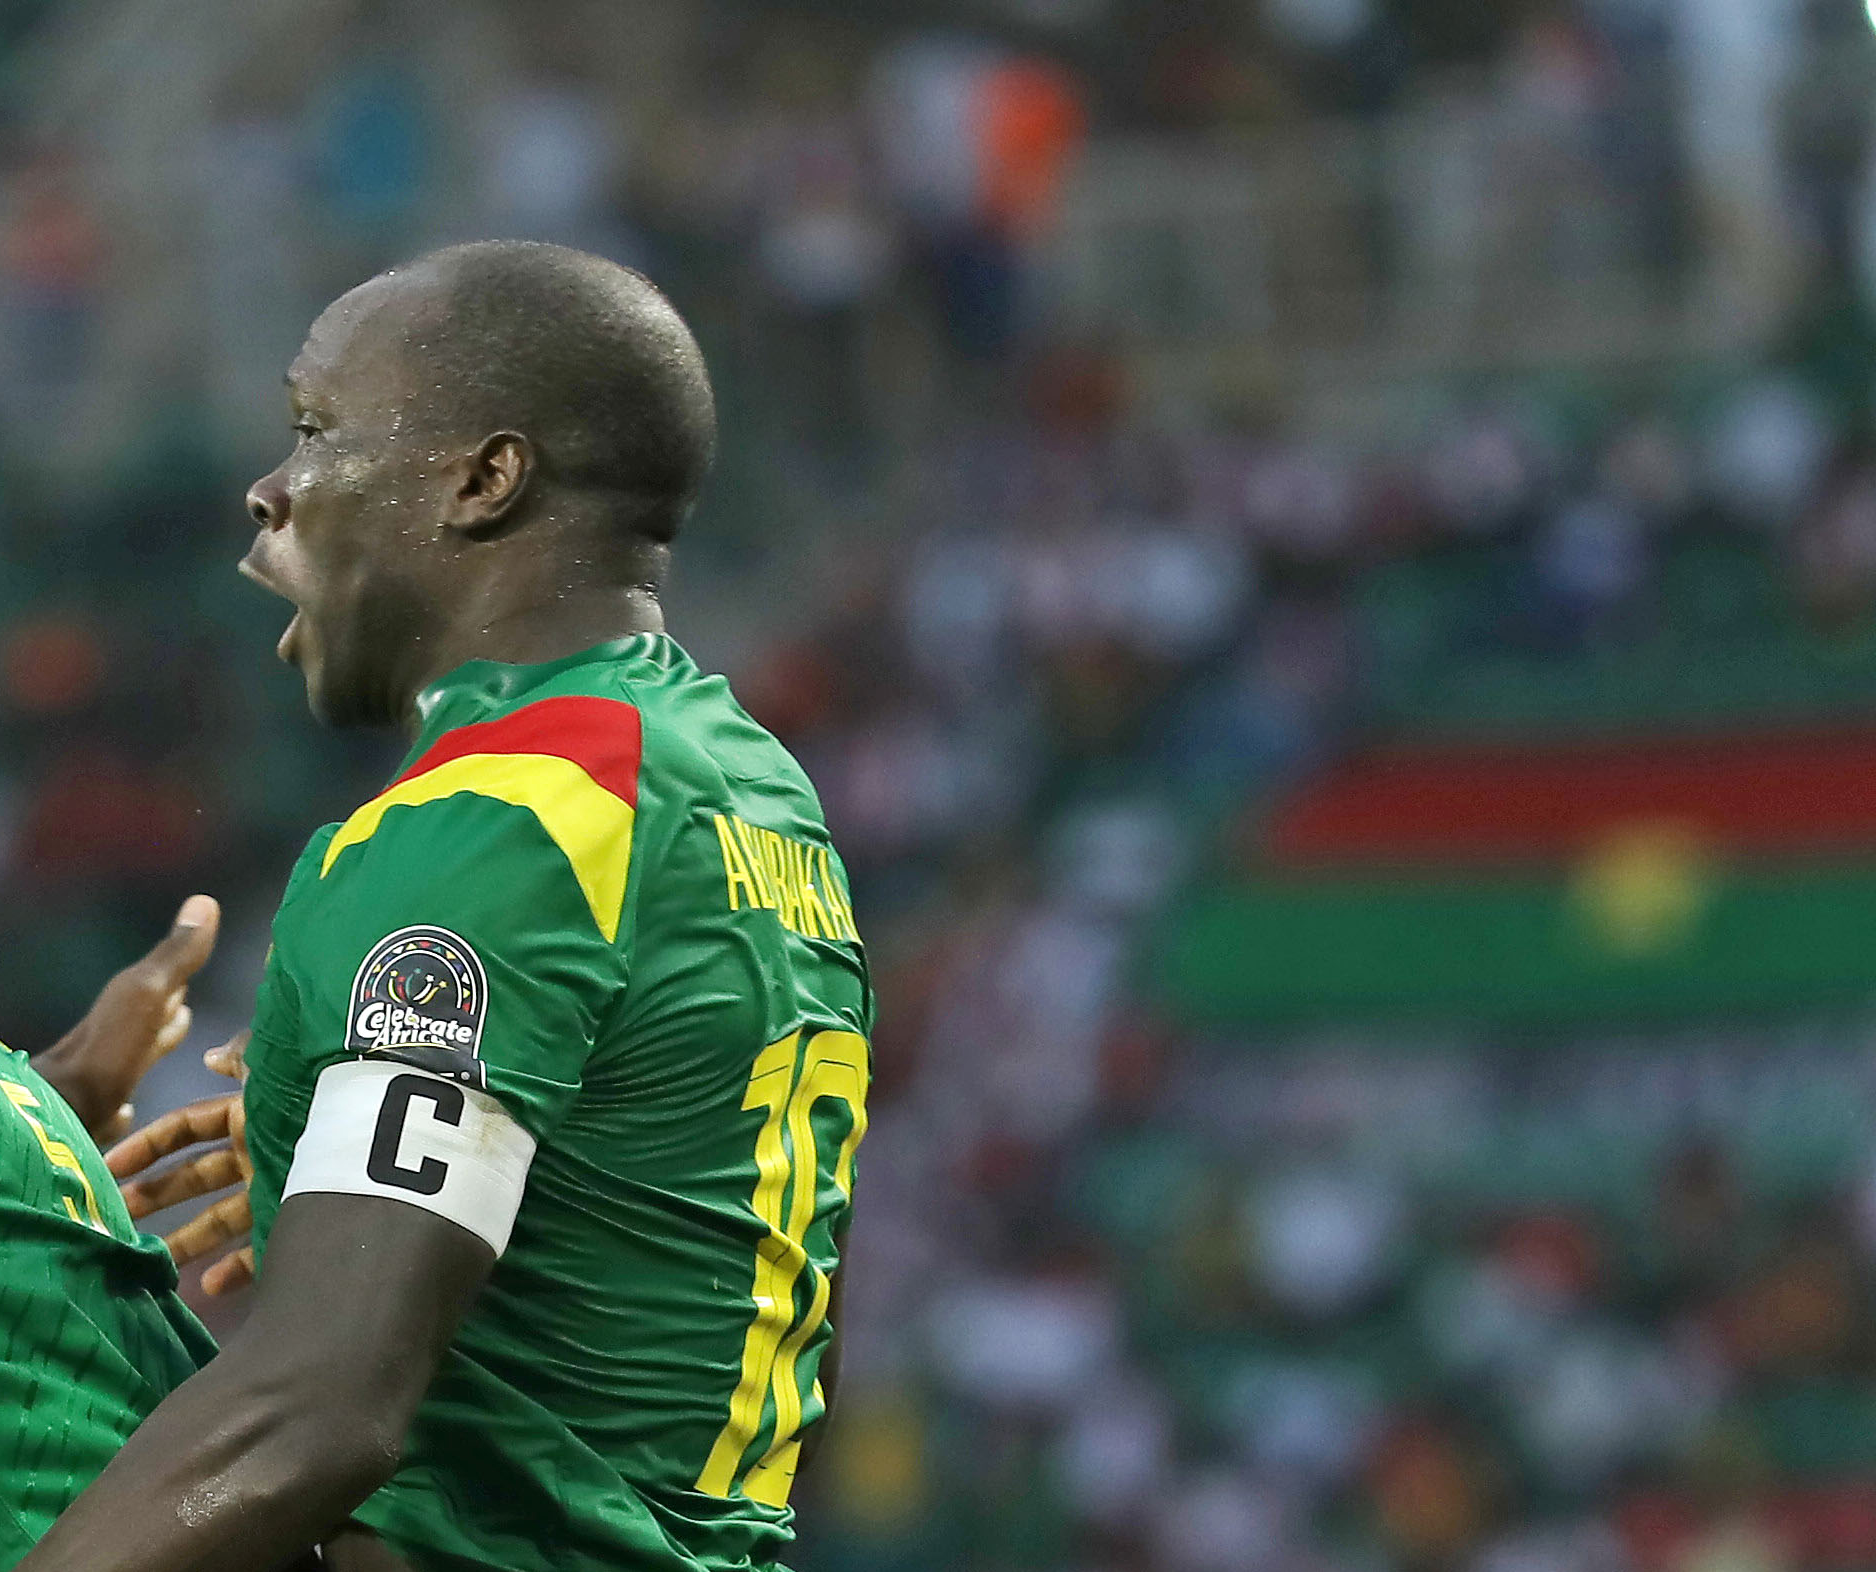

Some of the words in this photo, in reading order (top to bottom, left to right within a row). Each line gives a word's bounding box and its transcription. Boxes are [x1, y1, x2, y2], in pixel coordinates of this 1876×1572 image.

[355, 1001, 473, 1044] Celebrate
[366, 1073, 465, 1196] C
[694, 1027, 869, 1509] 10
